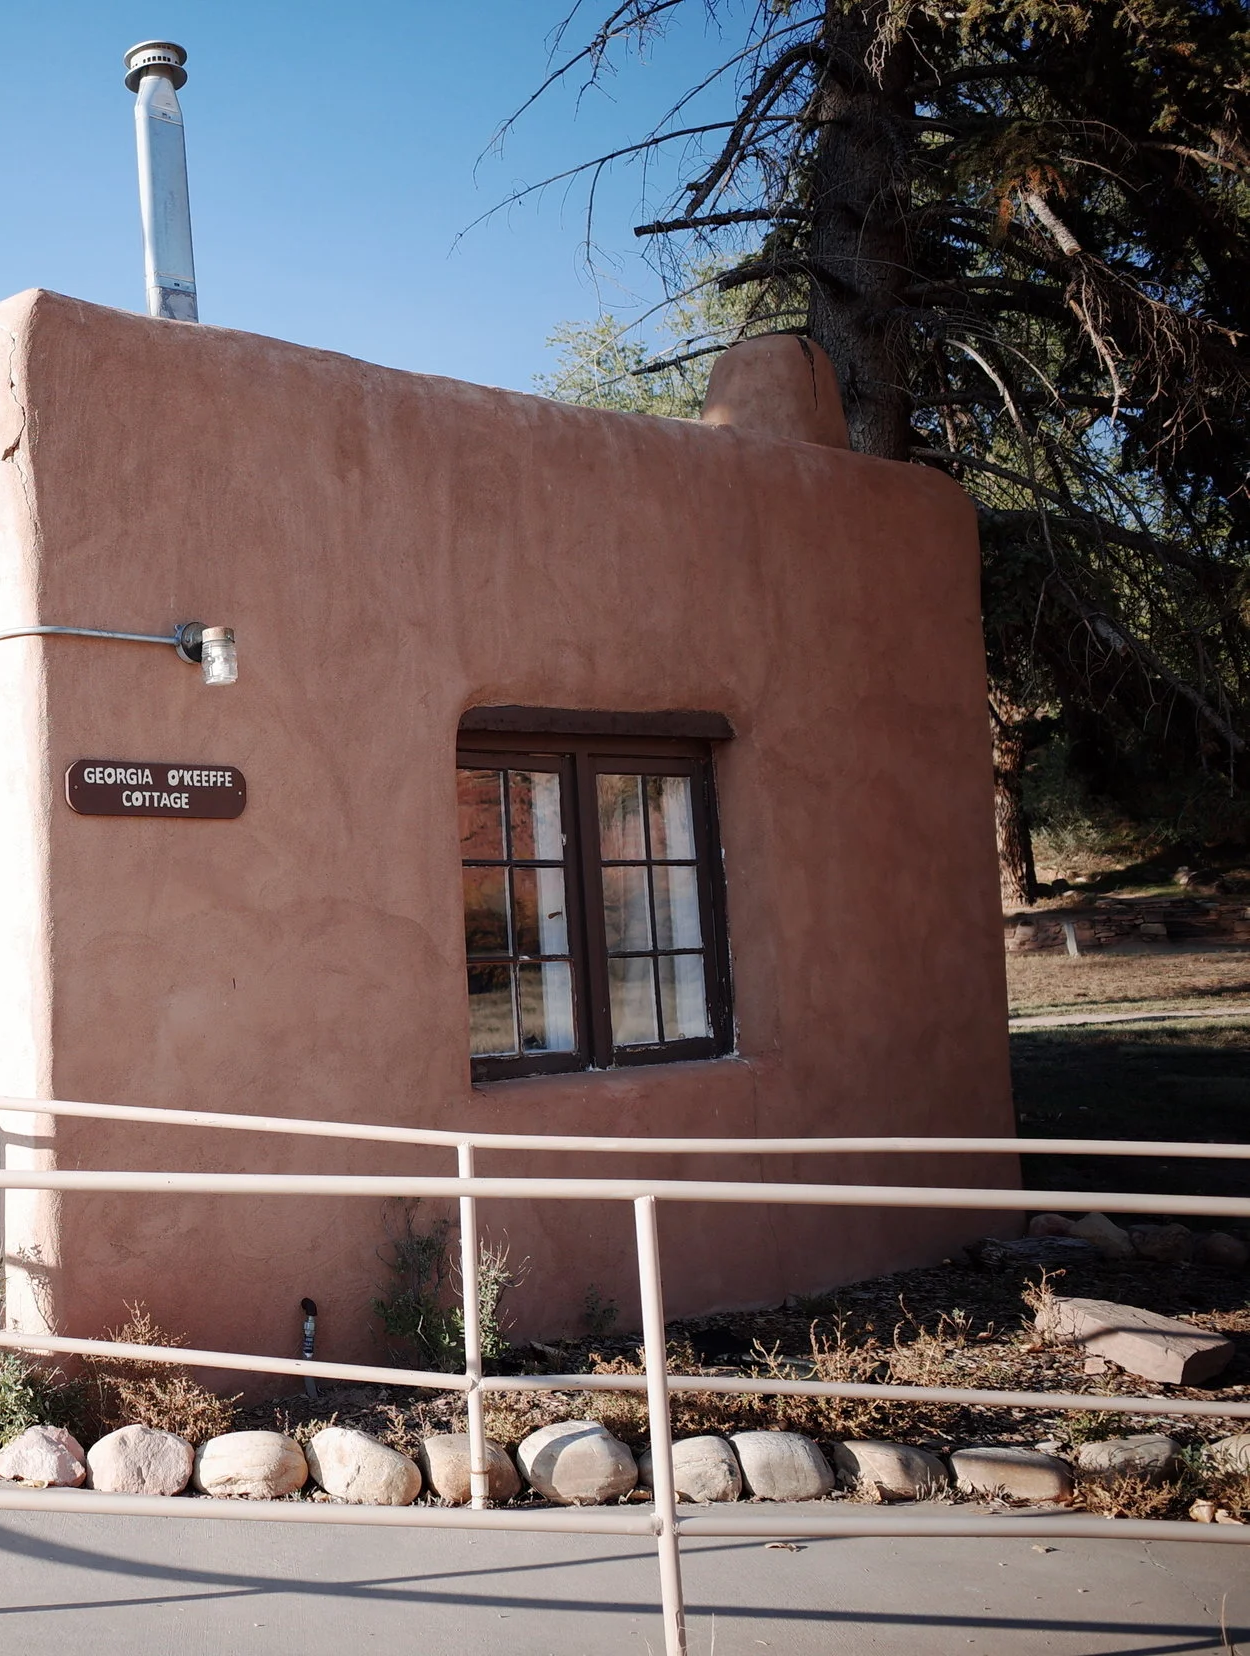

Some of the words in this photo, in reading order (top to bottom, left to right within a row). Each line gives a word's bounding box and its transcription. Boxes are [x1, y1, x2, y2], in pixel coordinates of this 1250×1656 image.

[83, 767, 153, 785] GEORGIA
[167, 769, 233, 787] O'KEEFFE
[122, 790, 190, 809] COTTAGE
